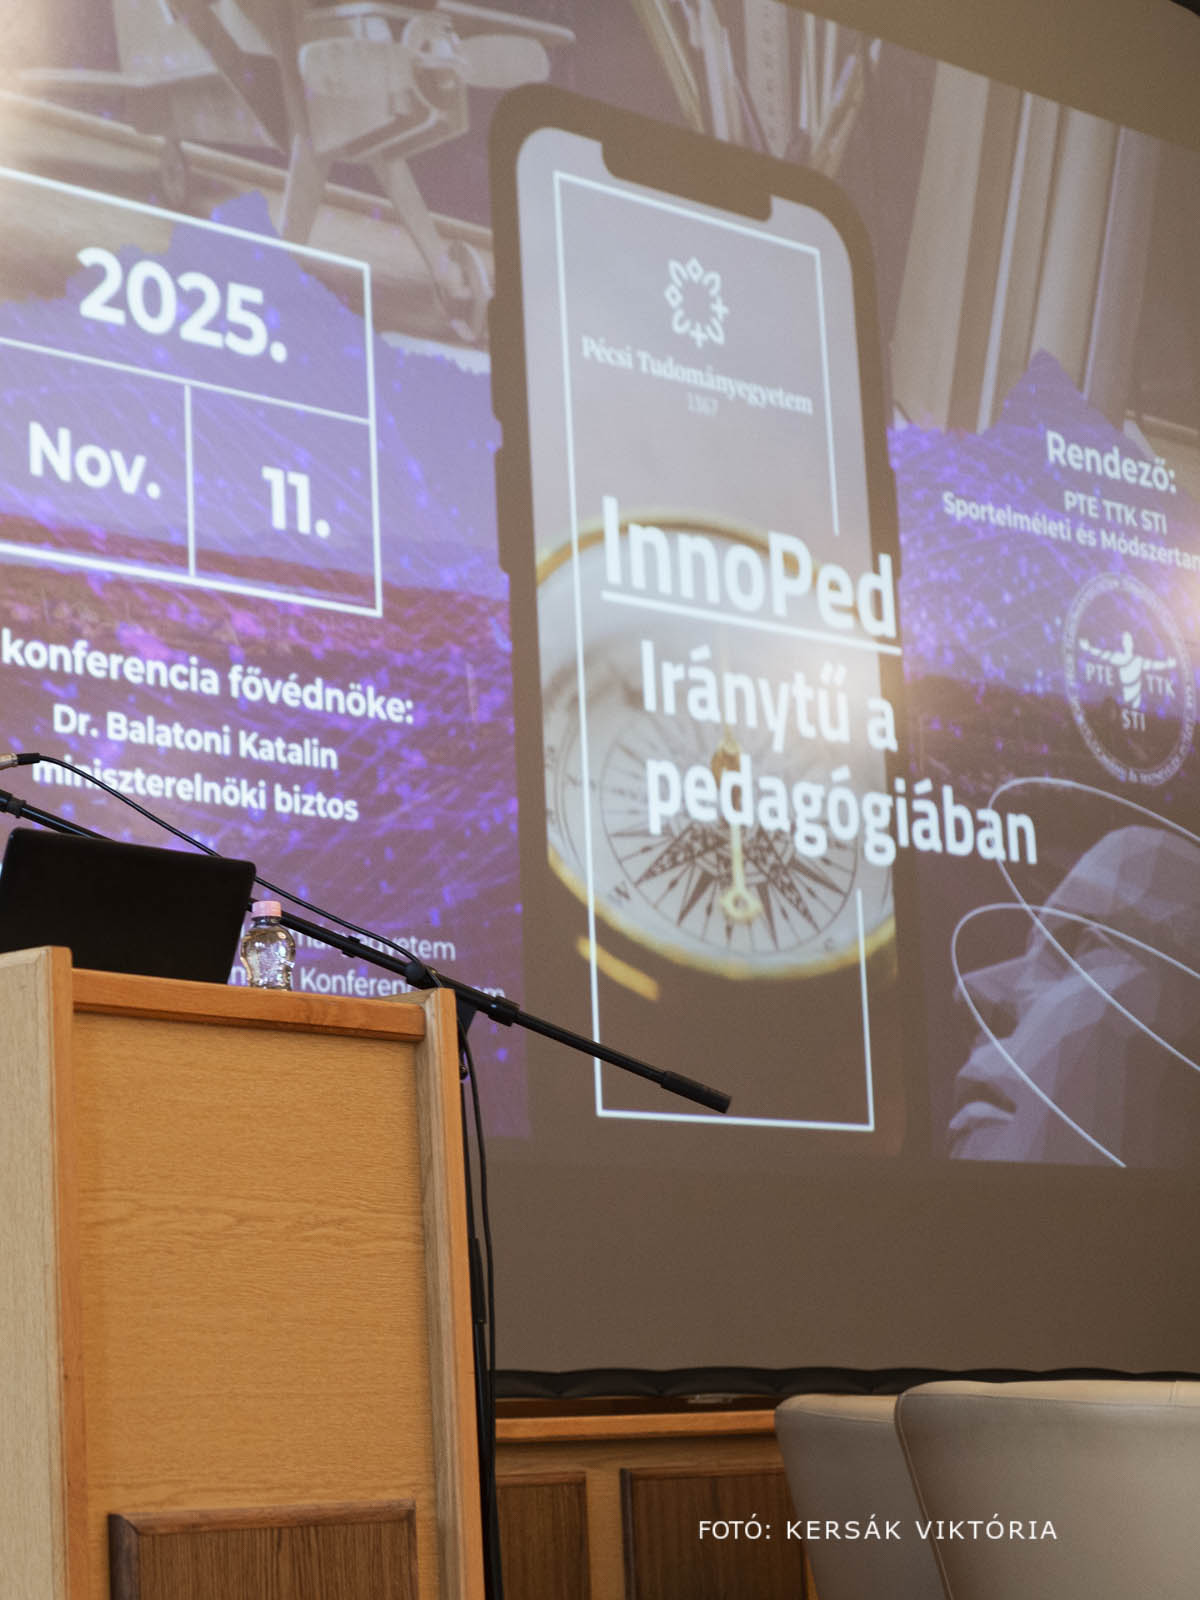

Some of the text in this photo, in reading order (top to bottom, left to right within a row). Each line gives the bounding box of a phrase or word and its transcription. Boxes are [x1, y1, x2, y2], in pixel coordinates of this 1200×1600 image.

[76, 246, 288, 364] 2025.
[581, 334, 814, 416] Pécsi Tudományegyetem
[28, 420, 332, 539] Nov. 11.
[1046, 429, 1177, 495] Rendező:
[942, 491, 1073, 542] Sportelméleti
[1076, 523, 1097, 547] és
[1063, 490, 1168, 535] PTE TTK STI
[601, 495, 897, 639] InnoPed
[0, 627, 221, 697] konferencia
[228, 664, 416, 724] fővédnöke:
[640, 639, 899, 753] Iránytű a
[1085, 662, 1115, 687] PTE
[53, 703, 339, 771] Dr. Balatoni Katalin
[1121, 708, 1146, 733] STI
[31, 754, 359, 822] miniszterelnöki biztos
[646, 755, 1038, 867] pedagógiában
